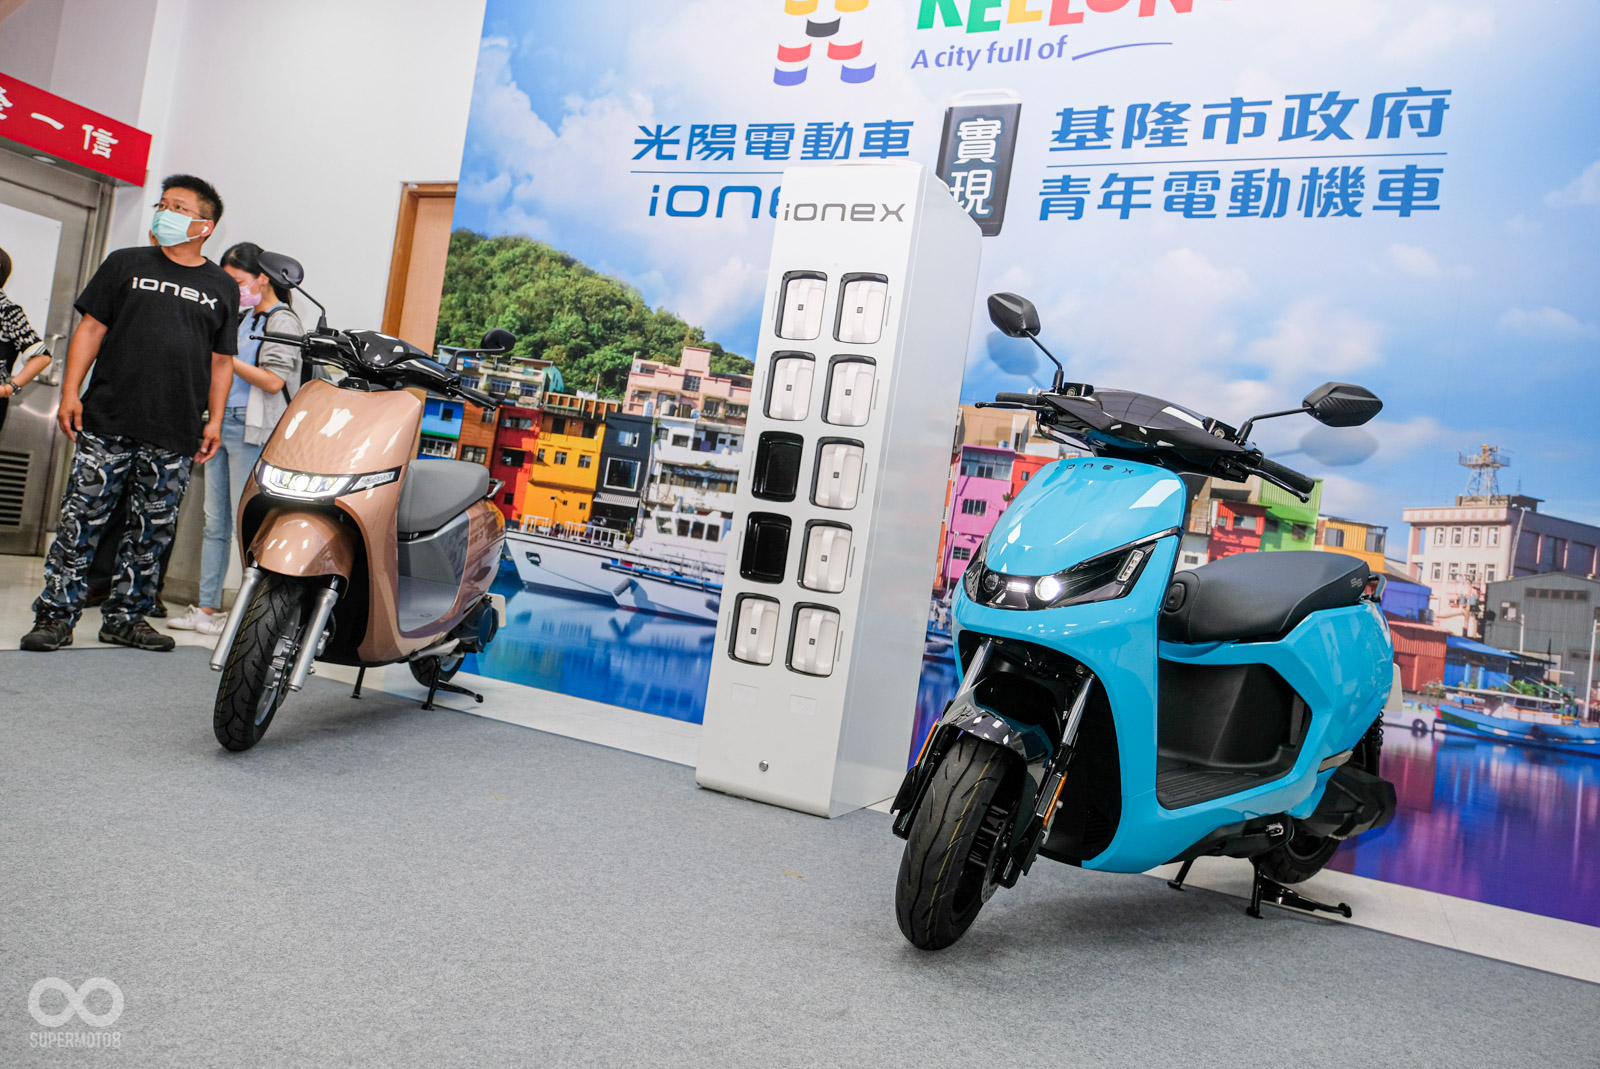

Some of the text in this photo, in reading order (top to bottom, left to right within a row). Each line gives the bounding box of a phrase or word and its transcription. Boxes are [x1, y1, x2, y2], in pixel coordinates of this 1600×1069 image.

[911, 34, 1068, 71] A city full of
[1049, 87, 1452, 152] 基隆市政府
[631, 120, 914, 161] 光陽電動車
[951, 118, 1001, 215] 實現
[784, 203, 906, 222] ionex
[1039, 164, 1444, 221] 青年電動機車
[132, 277, 218, 310] ionex
